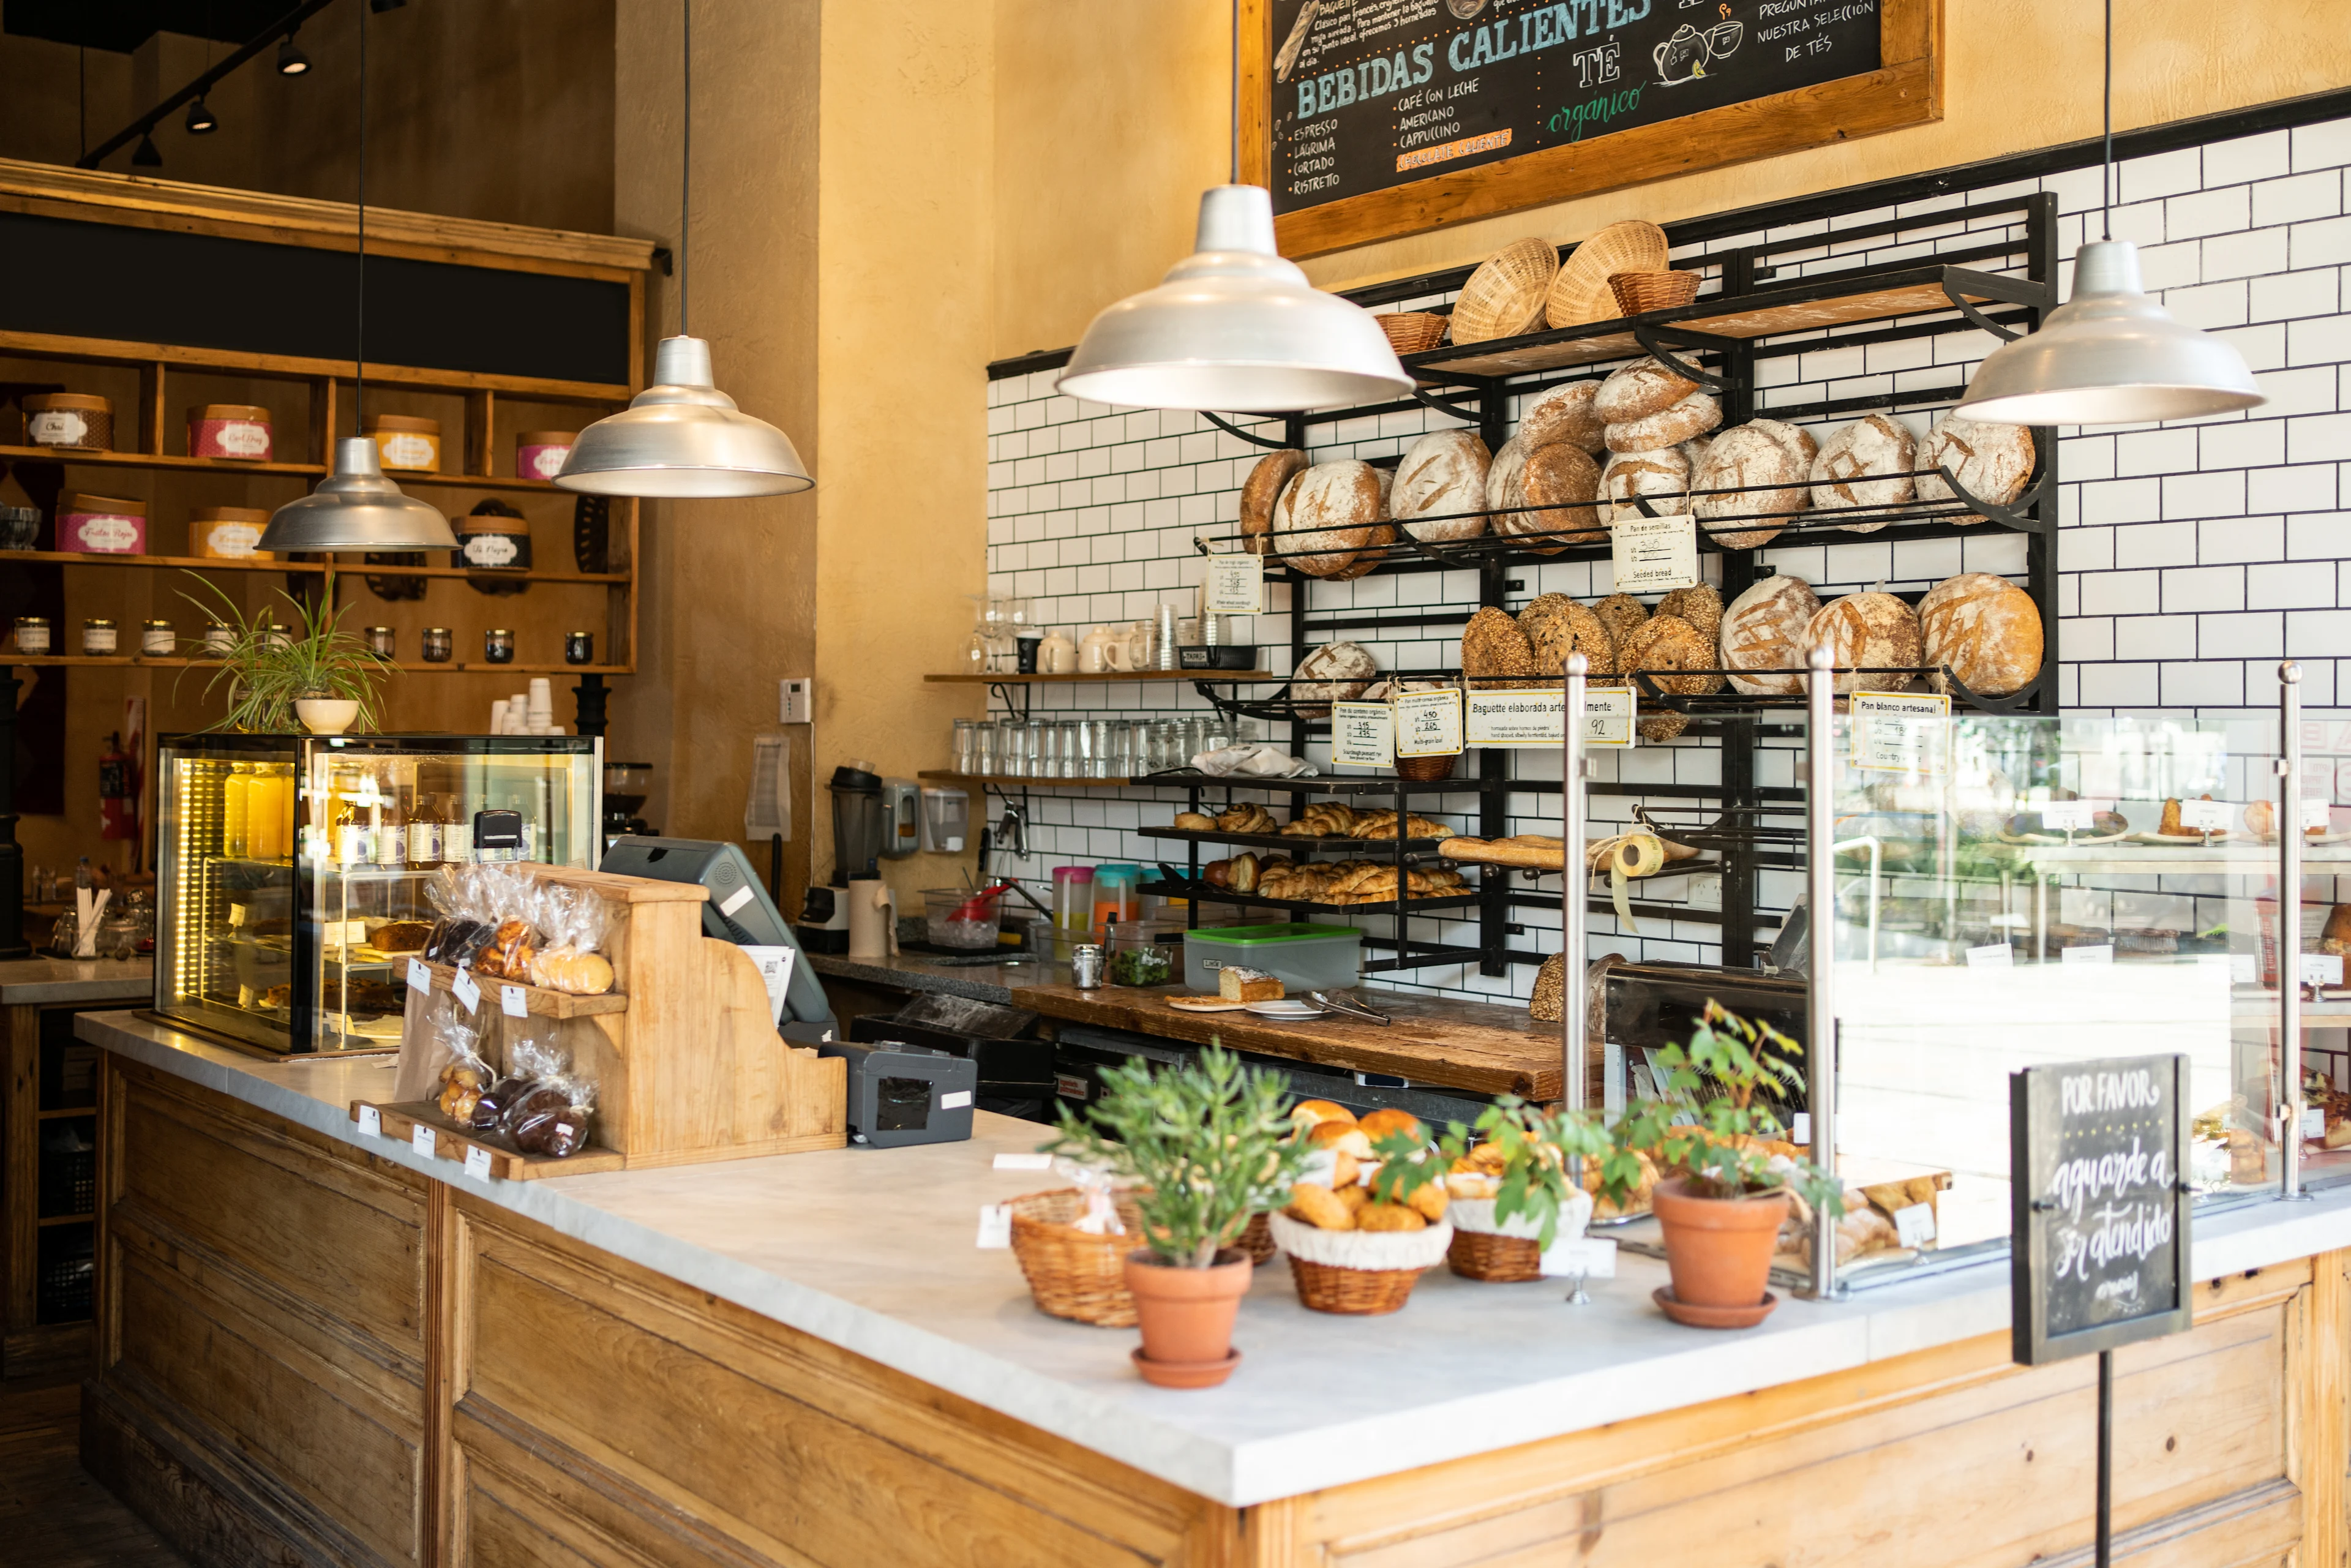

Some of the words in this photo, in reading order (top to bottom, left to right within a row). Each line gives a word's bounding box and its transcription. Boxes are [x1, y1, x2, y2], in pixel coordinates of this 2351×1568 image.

[1338, 13, 1351, 26] pan
[1759, 0, 1829, 20] PREGUNT
[1302, 48, 1311, 56] en
[1312, 45, 1319, 54] su
[1321, 39, 1339, 54] punto
[1400, 7, 1437, 26] horneadas
[1311, 33, 1327, 46] miga
[1357, 18, 1371, 28] Para
[1402, 4, 1410, 15] la
[1757, 18, 1810, 43] NUESTRA
[1297, 43, 1434, 119] BEBIDAS
[1448, 0, 1651, 72] CALIENTES
[1786, 45, 1801, 62] DE
[1806, 32, 1832, 56] TÉS
[1299, 59, 1306, 69] al
[1573, 34, 1620, 89] TÉ
[1398, 89, 1423, 111] CAFÉ
[1425, 89, 1443, 105] CON
[1448, 77, 1479, 99] LECHE
[1399, 106, 1454, 131] AMERICANO
[1546, 80, 1646, 142] orgánico
[1294, 119, 1338, 141] ESPRESSO
[1400, 122, 1461, 148] CAPPUCCINO
[1398, 144, 1454, 169] CHOCOLATE
[1459, 130, 1510, 154] CALIENTE
[1294, 157, 1335, 176] CORTADO
[1294, 173, 1340, 195] RISTRETTO
[1423, 710, 1437, 719] 450
[1472, 703, 1506, 715] Baguette
[1509, 702, 1547, 712] elaborada
[1550, 701, 1611, 711] artelmente
[1877, 702, 1900, 711] blanco
[1902, 705, 1937, 713] artesanal
[1425, 721, 1438, 730] 265
[1591, 719, 1605, 735] 92
[2061, 1075, 2092, 1117] POR
[2096, 1068, 2161, 1112] FAVOR
[2048, 1136, 2148, 1225] aguarde
[2150, 1150, 2177, 1189] a
[2089, 1201, 2173, 1268] atendido
